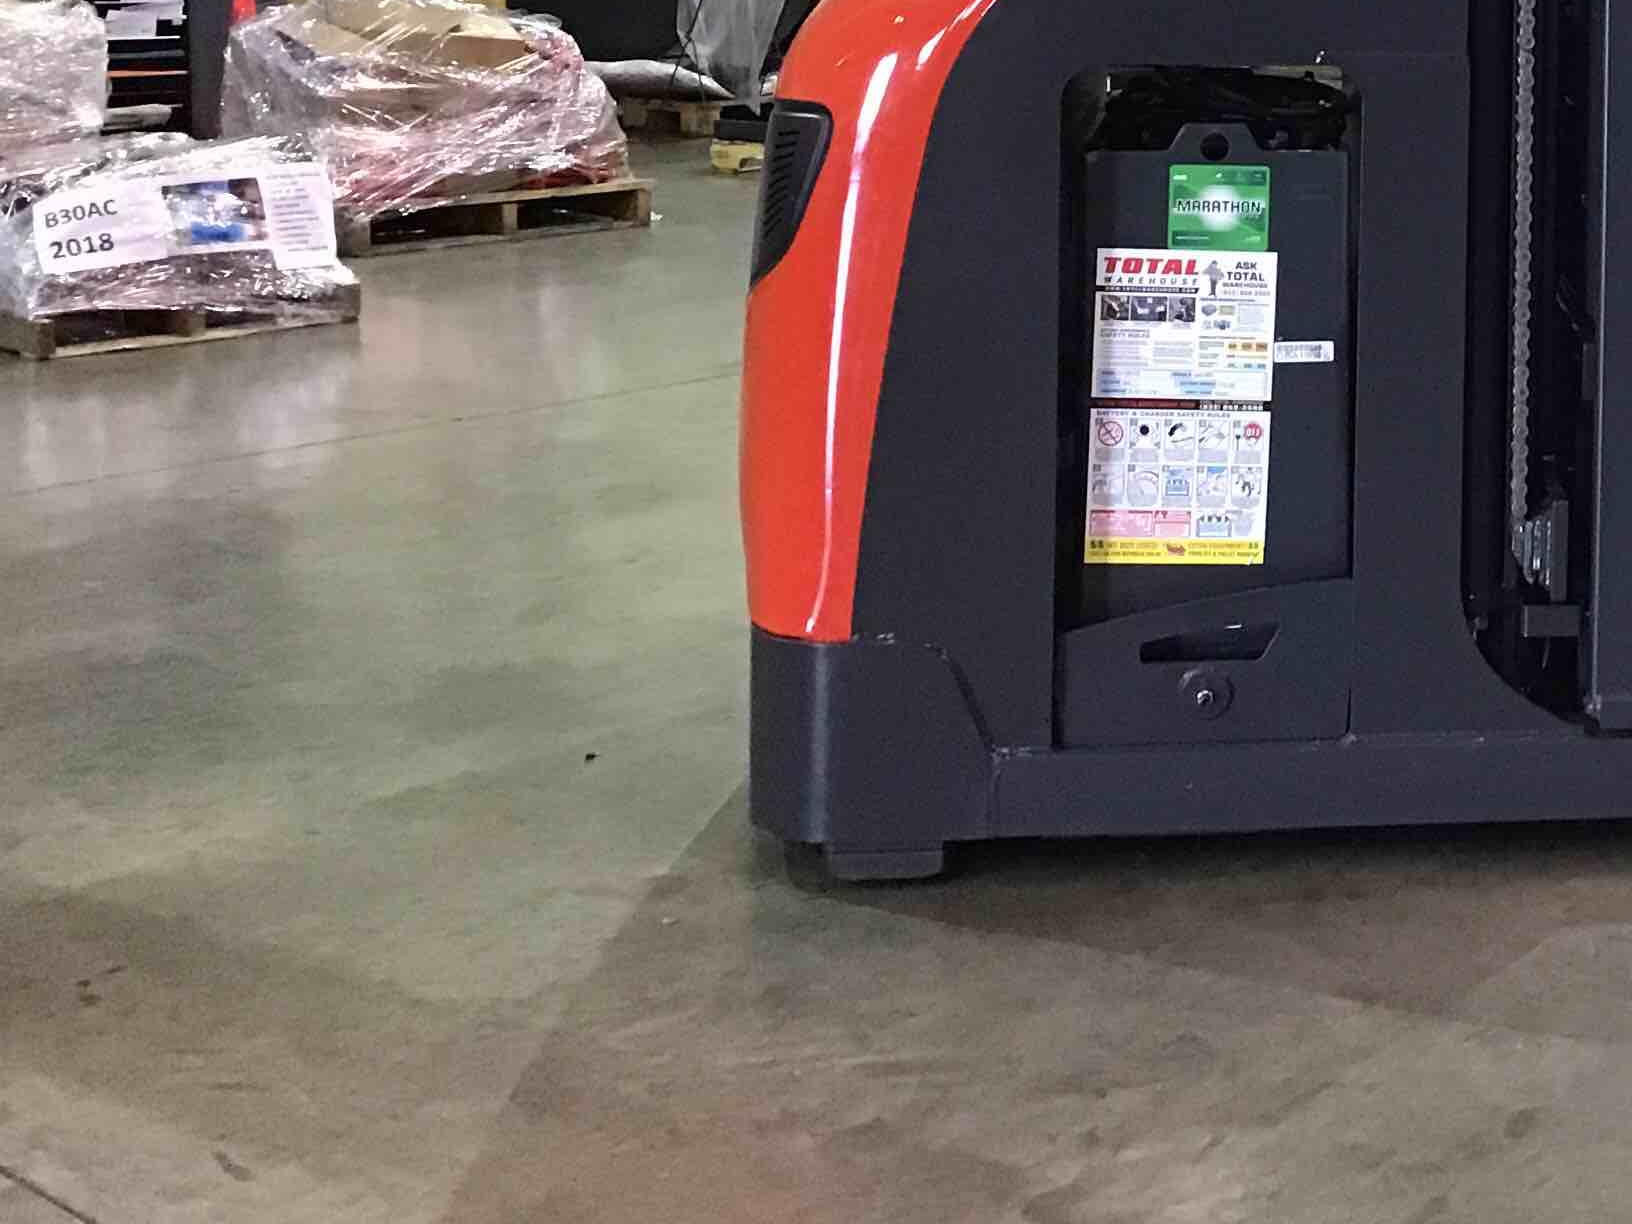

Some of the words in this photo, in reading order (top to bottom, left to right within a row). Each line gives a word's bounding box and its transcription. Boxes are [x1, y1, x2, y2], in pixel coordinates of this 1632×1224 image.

[1176, 200, 1262, 213] MARATHON
[44, 199, 118, 229] B30AC
[49, 232, 115, 259] 2018
[1104, 257, 1199, 276] TOTAL
[1235, 261, 1257, 270] ASK
[1104, 276, 1198, 285] WAREHOUSE
[1227, 272, 1265, 281] TOTAL
